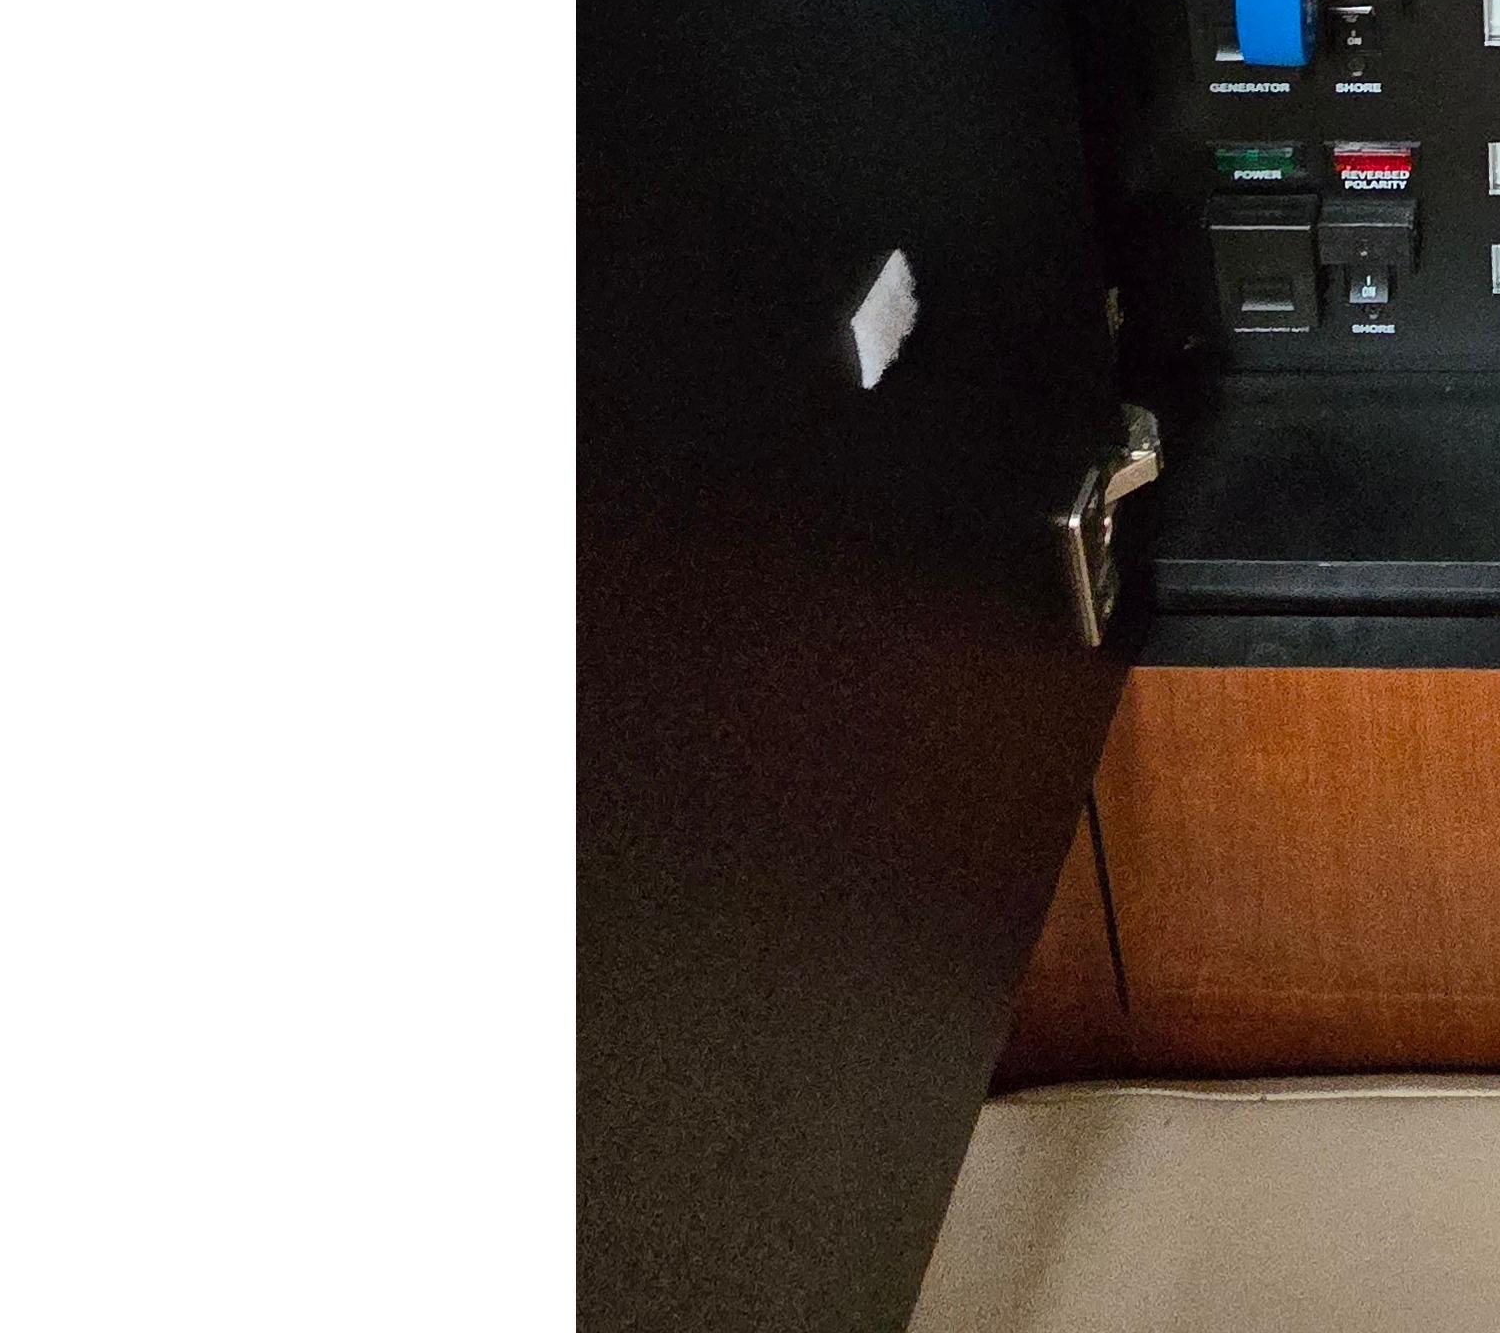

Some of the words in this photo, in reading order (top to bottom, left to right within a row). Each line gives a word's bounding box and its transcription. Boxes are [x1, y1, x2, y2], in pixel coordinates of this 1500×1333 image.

[1210, 83, 1290, 93] GENERATOR
[1336, 83, 1382, 93] SHORE
[1234, 170, 1282, 180] POWER
[1341, 170, 1410, 180] REVERSED
[1345, 180, 1407, 190] POLARITY
[1352, 324, 1395, 334] SHORE
